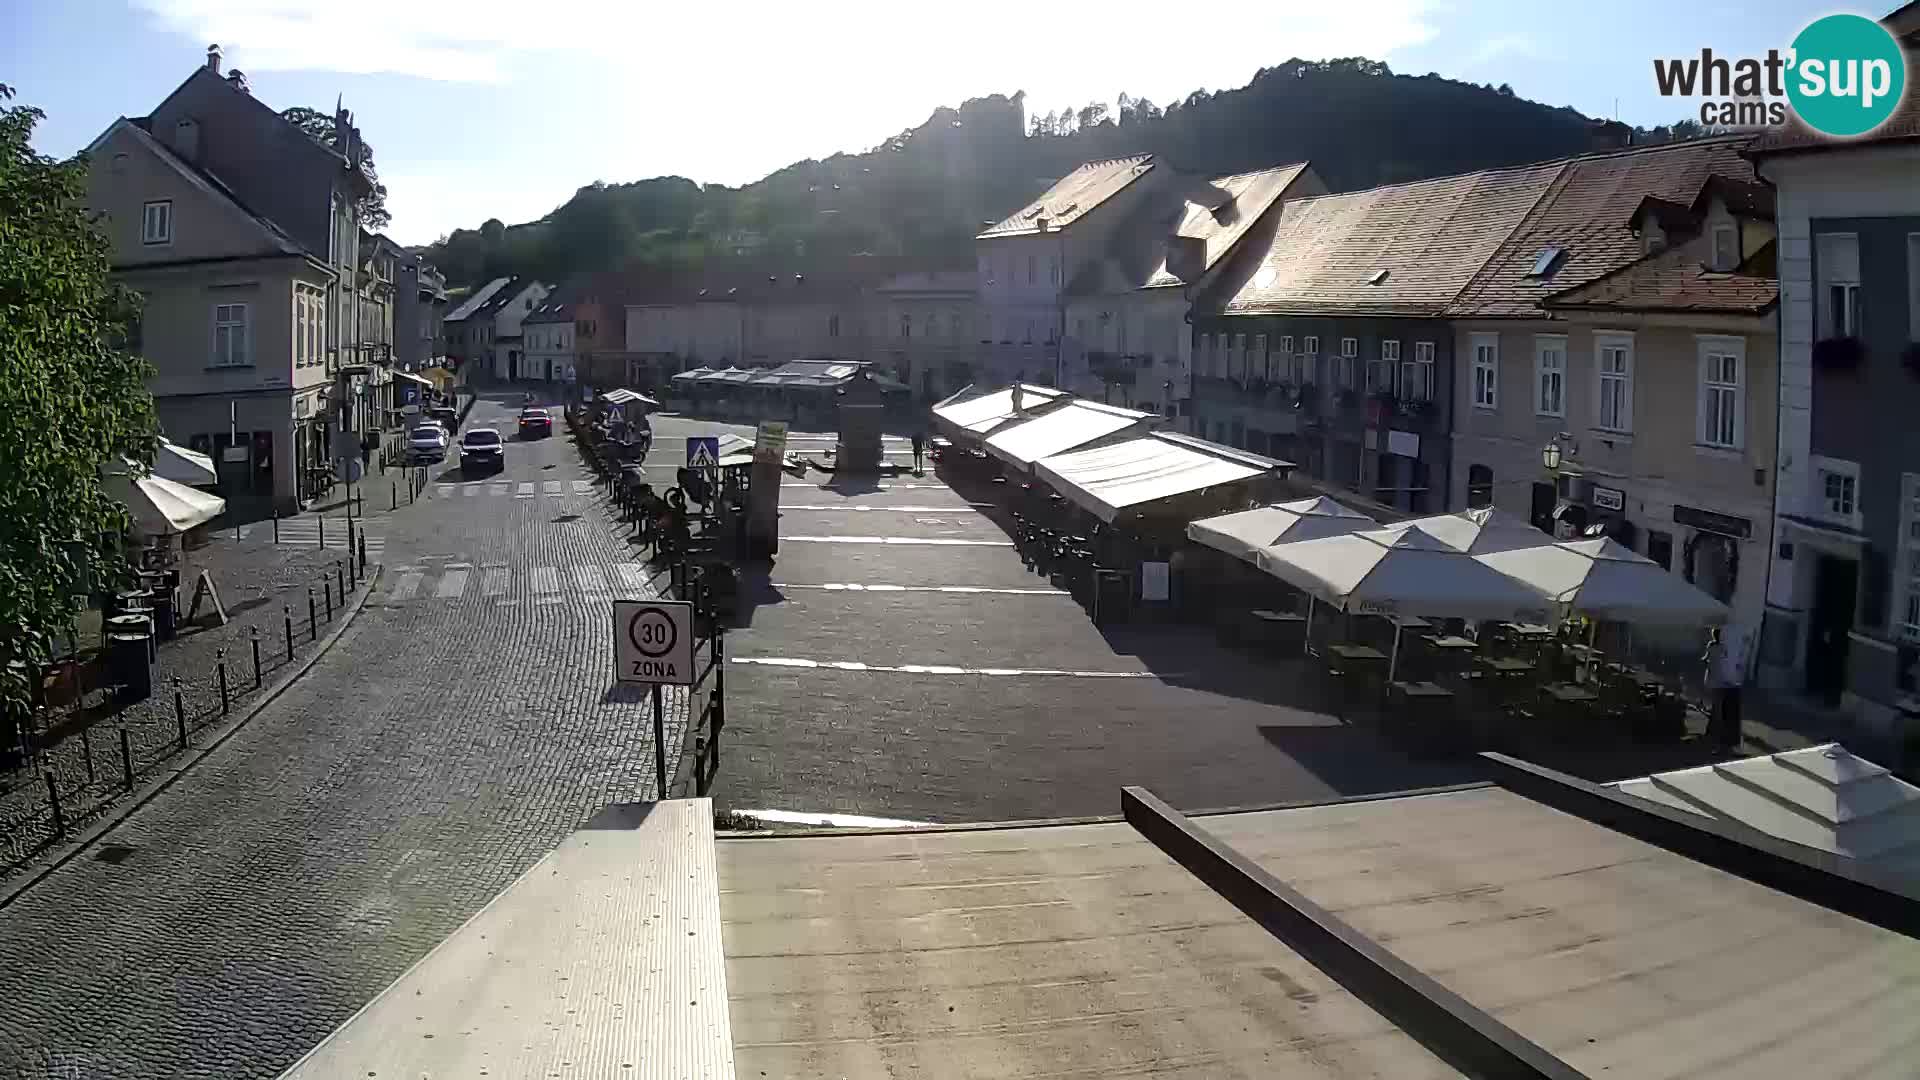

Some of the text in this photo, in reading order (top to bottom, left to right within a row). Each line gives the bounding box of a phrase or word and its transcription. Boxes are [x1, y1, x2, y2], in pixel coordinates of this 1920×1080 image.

[407, 391, 416, 402] P
[642, 623, 666, 645] 30
[632, 661, 677, 677] ZONA
